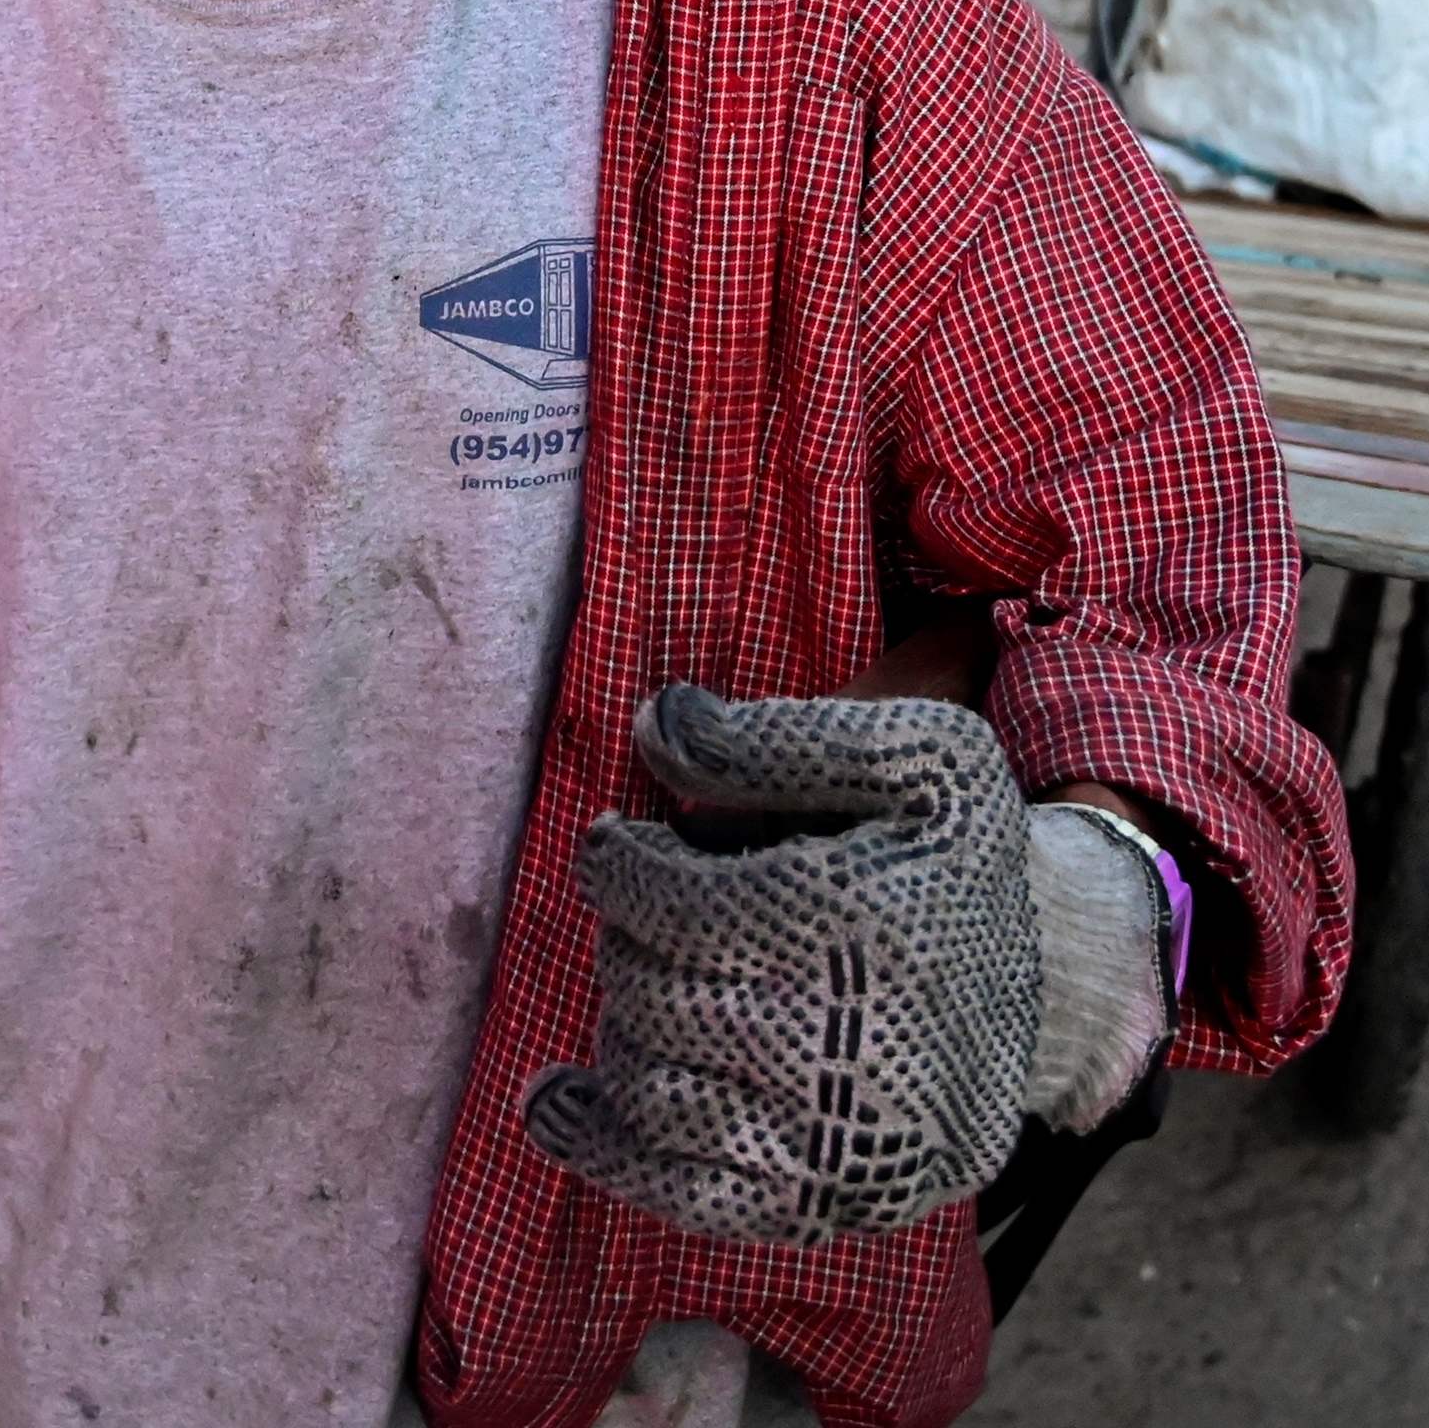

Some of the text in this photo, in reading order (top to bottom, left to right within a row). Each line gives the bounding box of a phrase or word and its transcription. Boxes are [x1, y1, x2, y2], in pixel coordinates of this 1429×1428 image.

[439, 297, 534, 320] JAMBCO
[460, 407, 529, 425] Opening
[534, 404, 580, 419] Doors
[450, 426, 591, 466] (954)97
